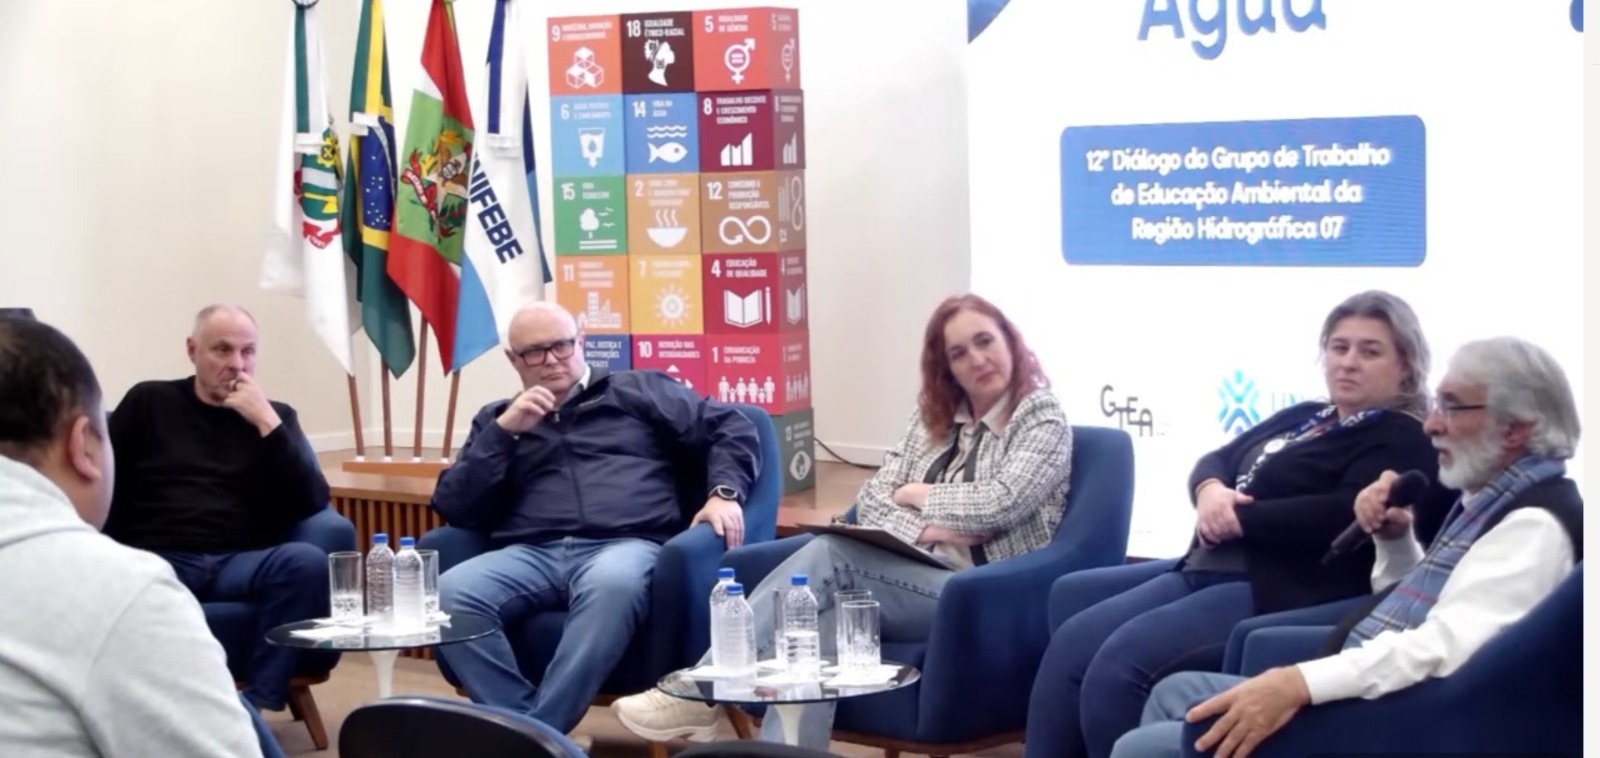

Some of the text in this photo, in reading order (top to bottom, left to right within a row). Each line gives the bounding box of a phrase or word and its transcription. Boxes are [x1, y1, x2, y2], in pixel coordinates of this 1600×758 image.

[626, 20, 641, 37] 18
[704, 15, 714, 33] 5
[552, 25, 561, 42] 9
[561, 104, 570, 120] 6
[632, 101, 646, 118] 14
[703, 97, 712, 115] 8
[1113, 148, 1181, 176] Diálogo
[1184, 148, 1209, 169] do
[1211, 147, 1270, 173] Grupo
[1273, 145, 1299, 167] de
[1302, 143, 1391, 167] Trabalho
[561, 182, 576, 201] 15
[635, 180, 644, 198] 2
[706, 181, 723, 201] 12
[1111, 179, 1363, 211] de Educação Ambiental da
[468, 152, 524, 265] NIFEBE
[1132, 216, 1345, 245] Região Hidrográfica 07
[711, 259, 722, 278] 4
[638, 341, 653, 358] 10
[712, 346, 718, 363] 1
